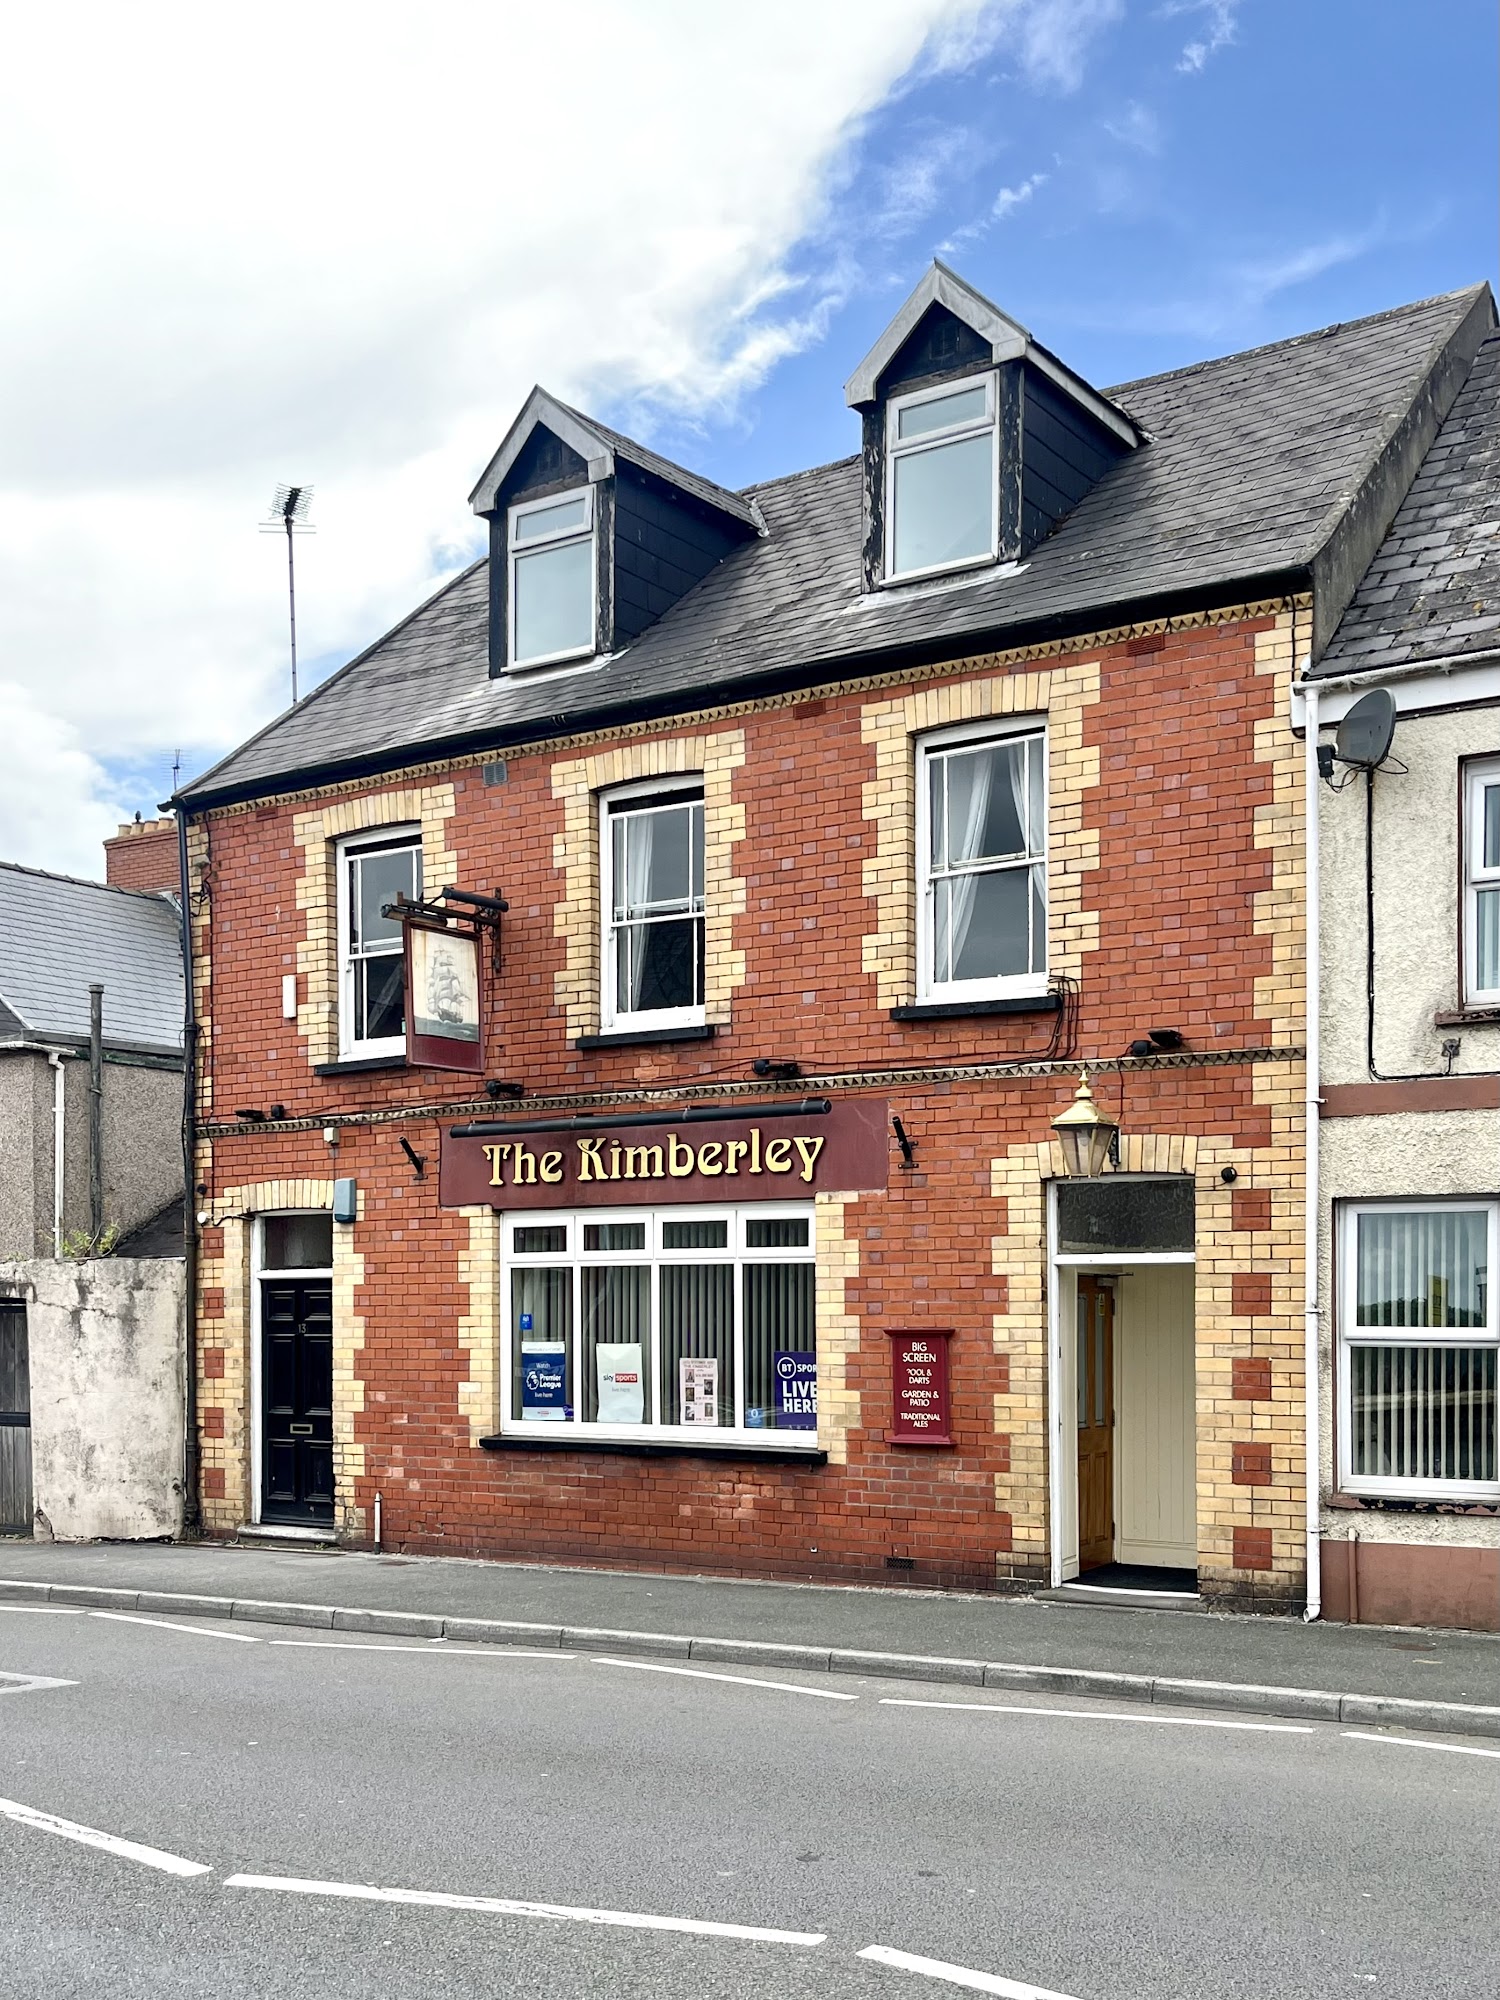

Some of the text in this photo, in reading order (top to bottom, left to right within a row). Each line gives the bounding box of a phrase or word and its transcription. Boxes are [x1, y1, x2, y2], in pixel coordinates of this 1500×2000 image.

[482, 1128, 824, 1186] The Kimberley
[298, 1323, 306, 1333] 13
[911, 1342, 927, 1351] BIG
[902, 1353, 936, 1362] SCREEN
[781, 1363, 817, 1373] BT SPOR
[603, 1374, 613, 1382] sky
[540, 1381, 561, 1389] League
[783, 1380, 817, 1398] LIVE
[901, 1390, 931, 1398] GARDEN
[783, 1398, 817, 1413] HERE
[900, 1412, 941, 1421] TRADITIONAL
[913, 1420, 928, 1428] ALES
